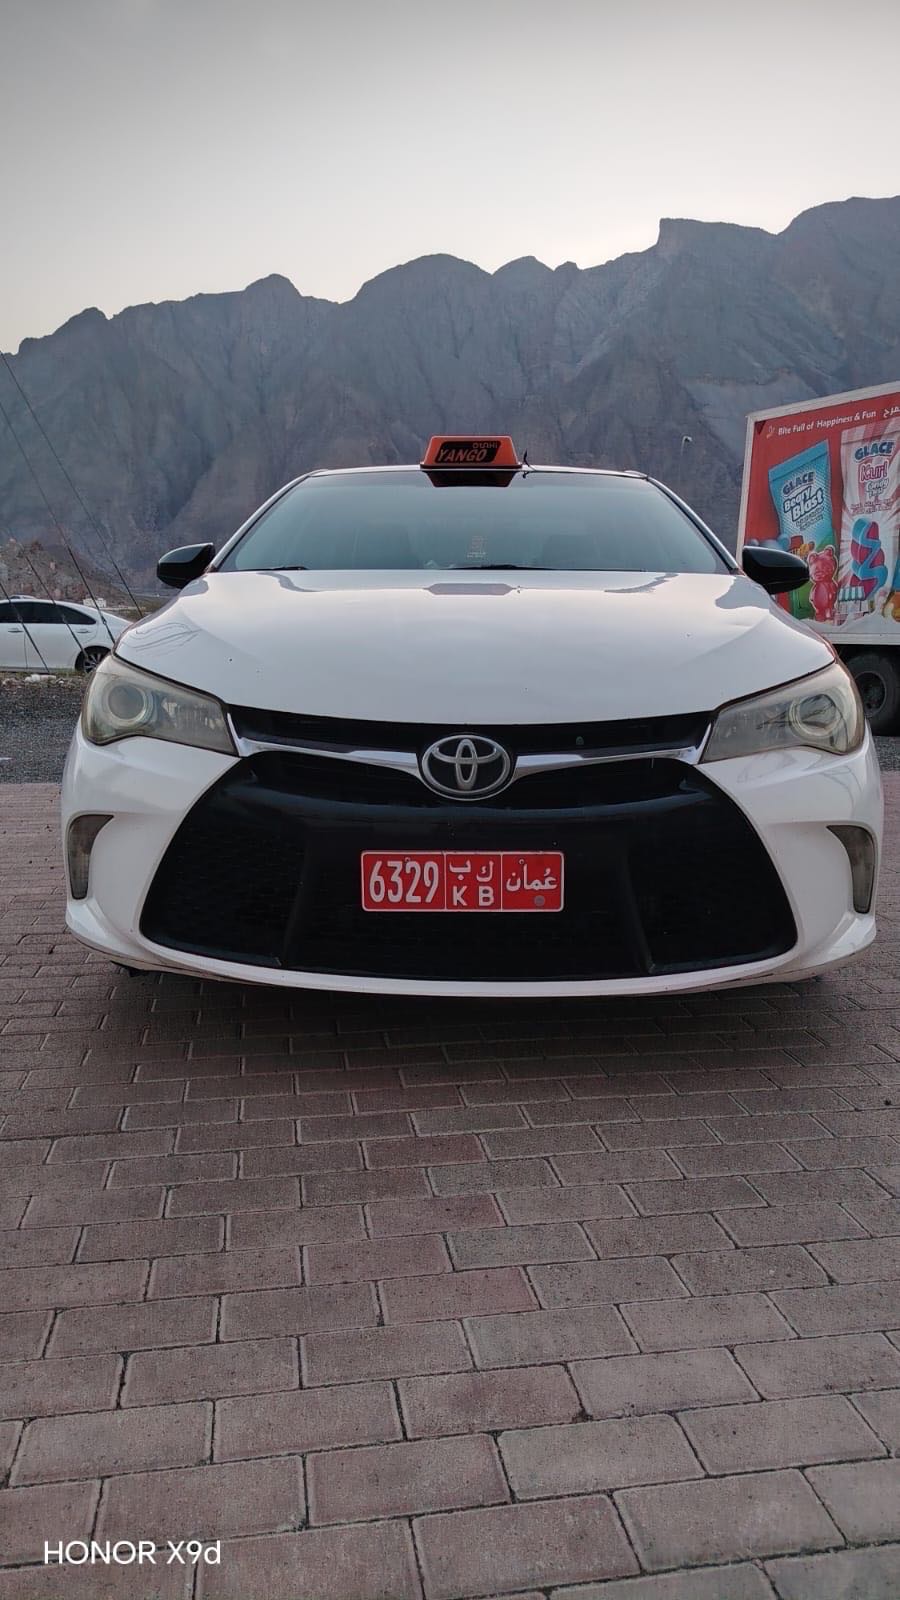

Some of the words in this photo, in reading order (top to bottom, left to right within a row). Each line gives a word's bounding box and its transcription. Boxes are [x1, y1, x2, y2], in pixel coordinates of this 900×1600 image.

[778, 425, 791, 436] Bite
[792, 423, 806, 433] Full
[806, 422, 814, 430] of
[816, 415, 853, 428] Happiness
[862, 410, 876, 419] Fun
[438, 448, 487, 461] YANGO
[855, 442, 894, 460] GLACE
[783, 471, 815, 494] GLACE
[791, 488, 824, 522] Blast
[369, 861, 439, 903] 6329
[453, 885, 468, 906] K
[478, 885, 495, 906] B
